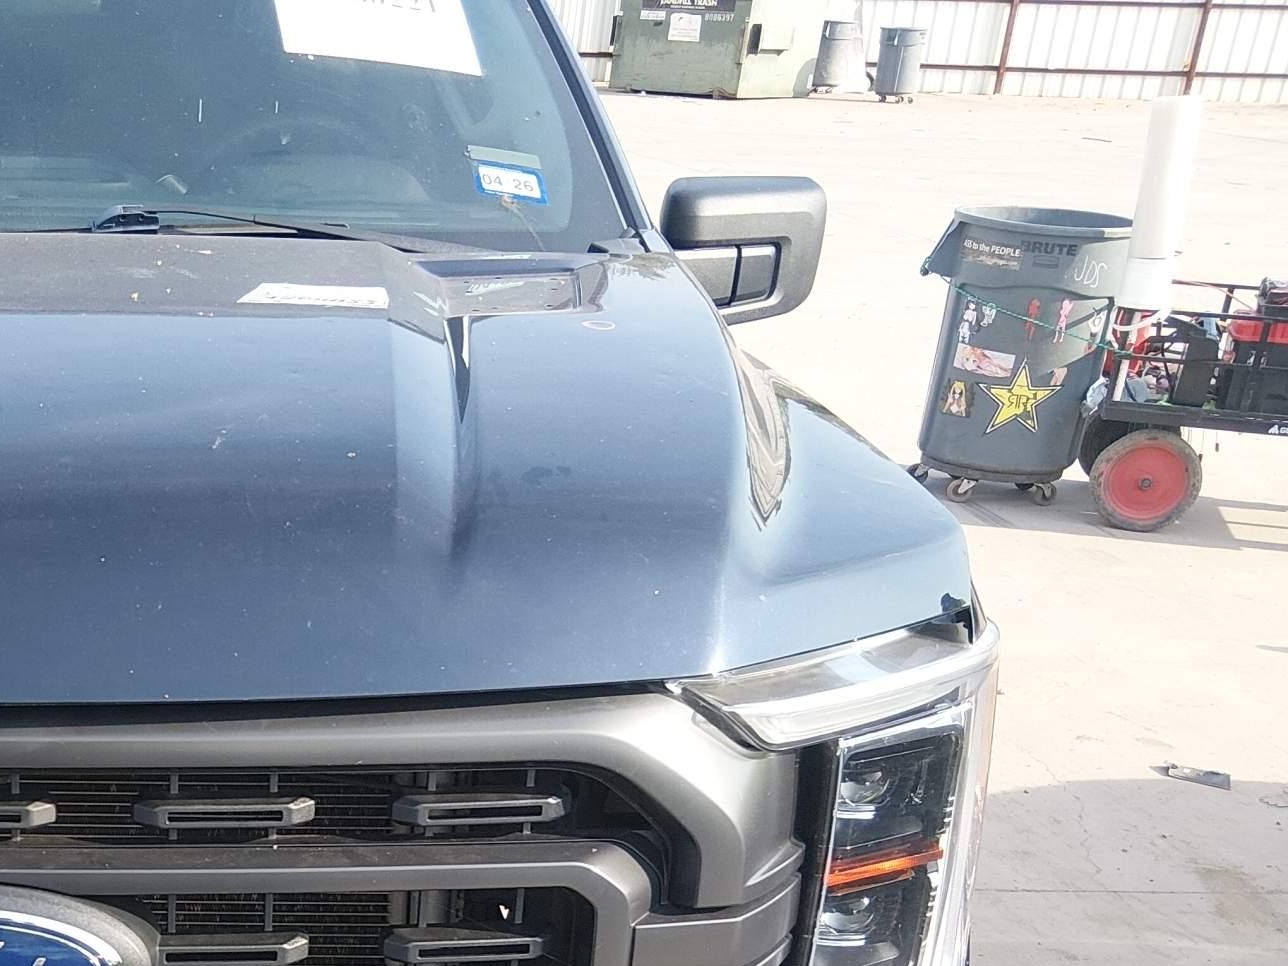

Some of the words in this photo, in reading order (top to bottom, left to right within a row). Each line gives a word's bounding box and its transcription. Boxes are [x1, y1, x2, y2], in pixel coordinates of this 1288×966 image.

[482, 174, 503, 187] 04
[512, 178, 534, 192] 26
[972, 241, 979, 250] to
[979, 242, 990, 253] the
[1020, 240, 1079, 257] BRUTE
